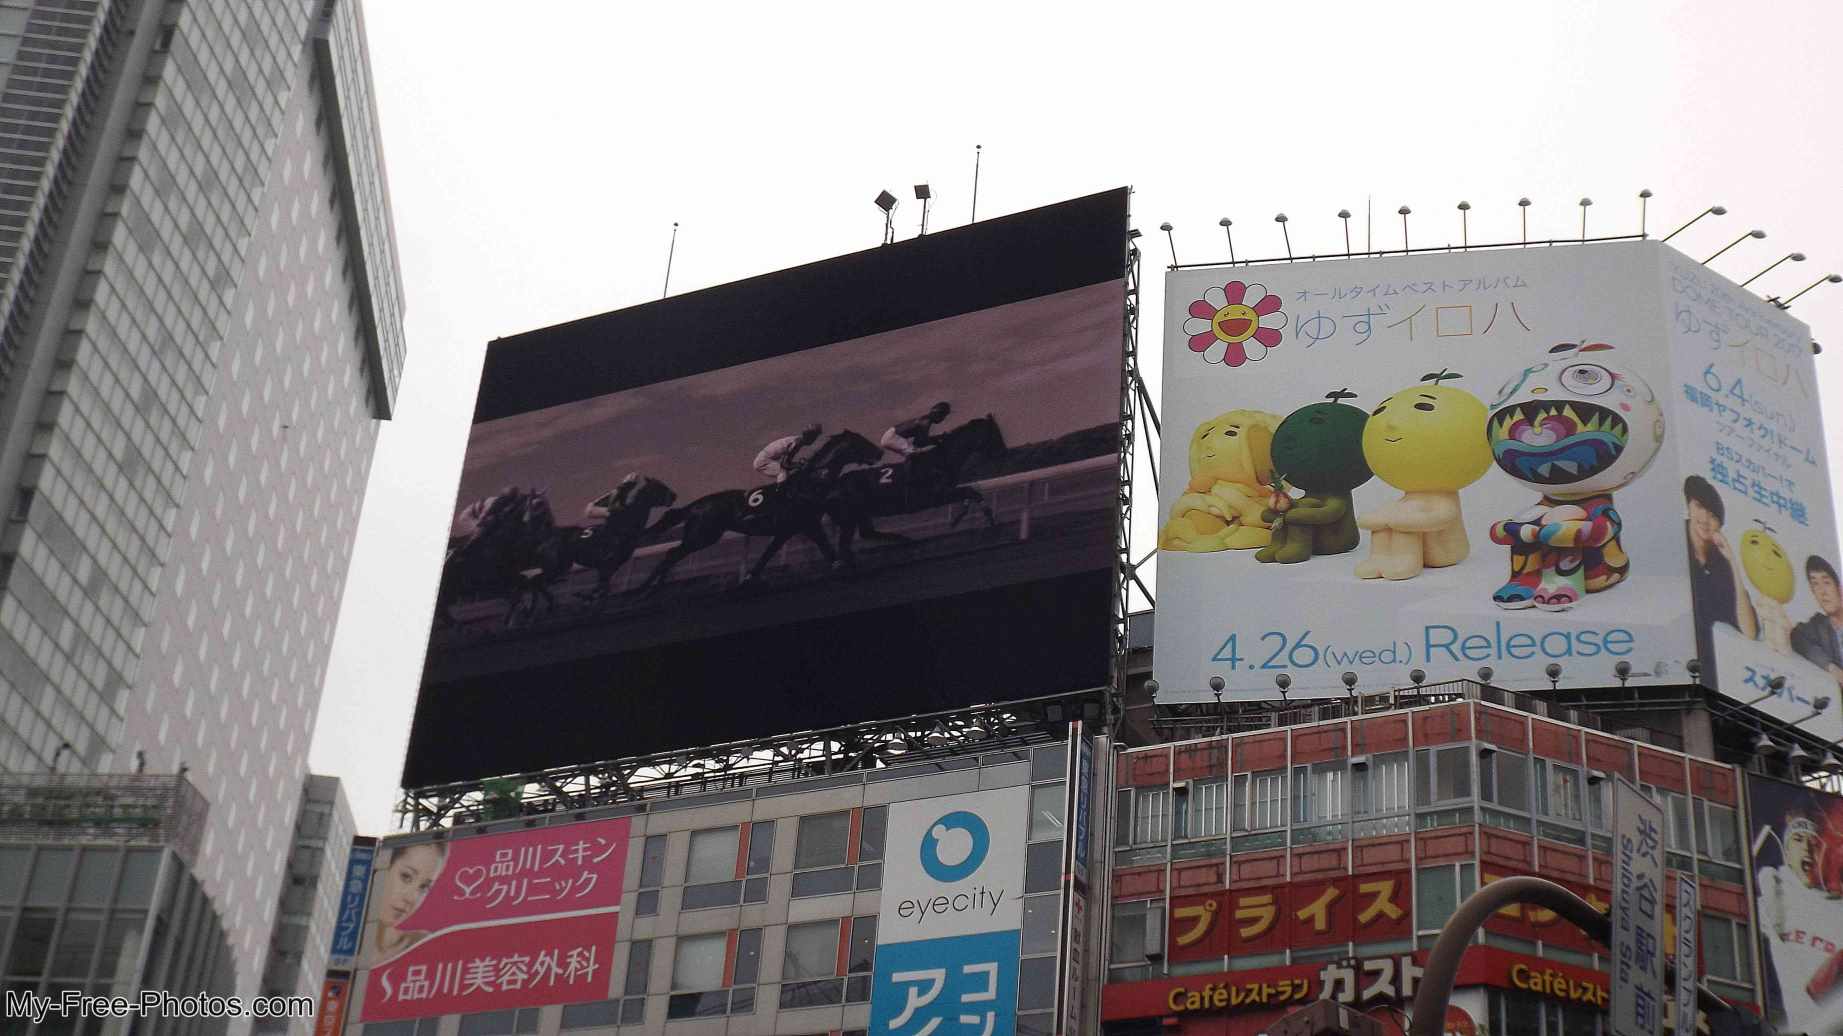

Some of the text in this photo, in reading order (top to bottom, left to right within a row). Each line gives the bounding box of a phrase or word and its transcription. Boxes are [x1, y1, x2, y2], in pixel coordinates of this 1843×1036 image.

[1296, 275, 1527, 301] オールタイムベストアルバム
[879, 466, 894, 485] 2
[748, 489, 764, 507] 6
[1424, 621, 1635, 664] Release
[489, 836, 617, 878] 品川スキン
[485, 870, 599, 909] クリニック
[897, 885, 1005, 924] eyecity
[1173, 880, 1404, 947] プライス
[397, 944, 599, 1002] 品川美容外科
